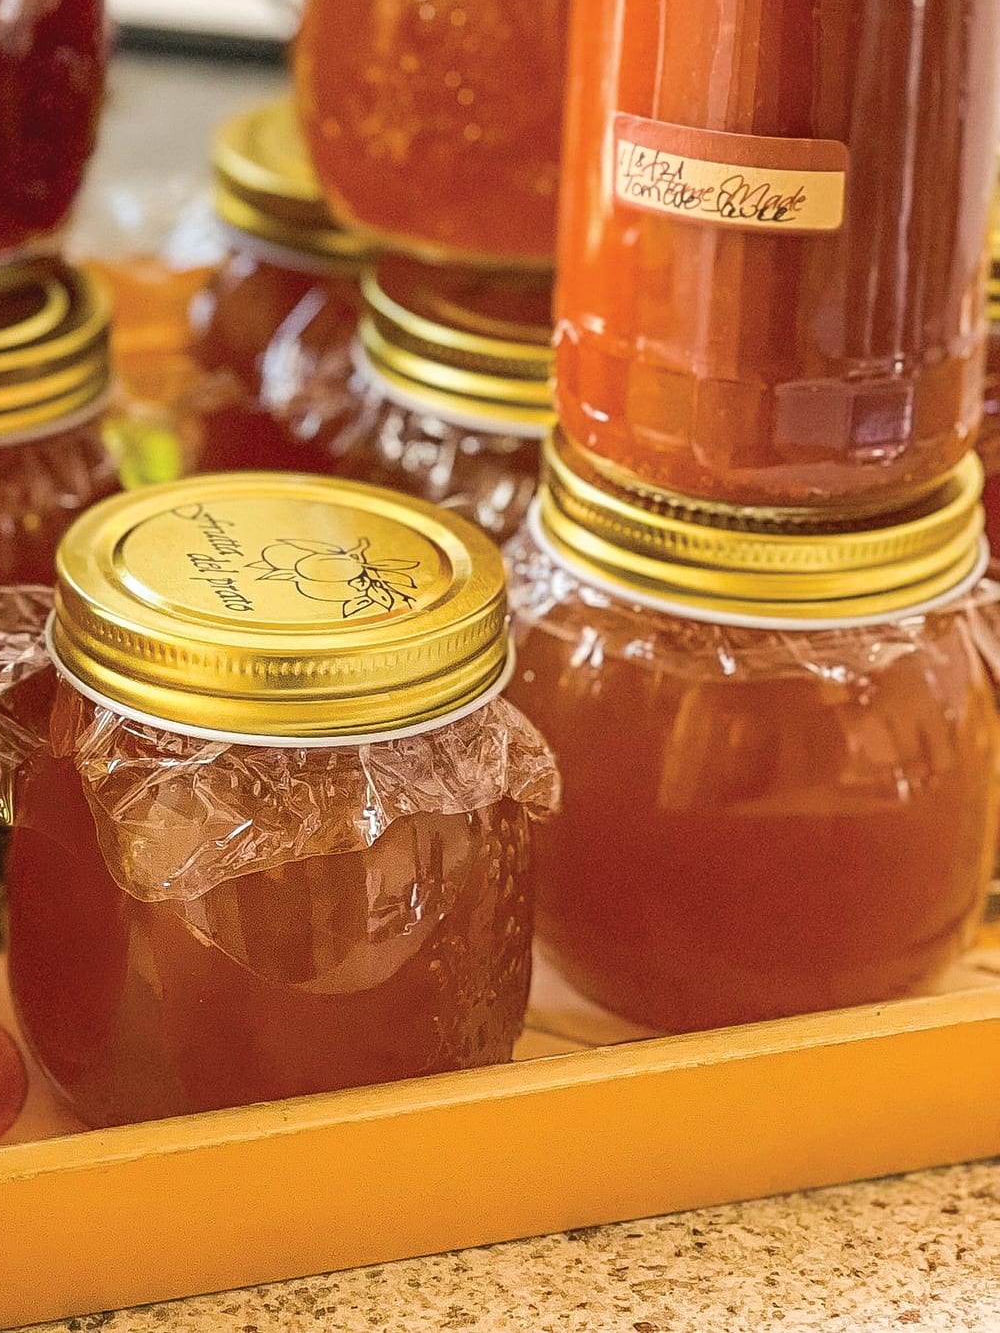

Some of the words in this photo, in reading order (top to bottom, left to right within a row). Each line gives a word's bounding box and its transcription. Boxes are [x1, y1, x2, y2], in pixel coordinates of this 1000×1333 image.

[720, 175, 806, 211] Made
[186, 553, 239, 573] del
[189, 578, 255, 612] prato
